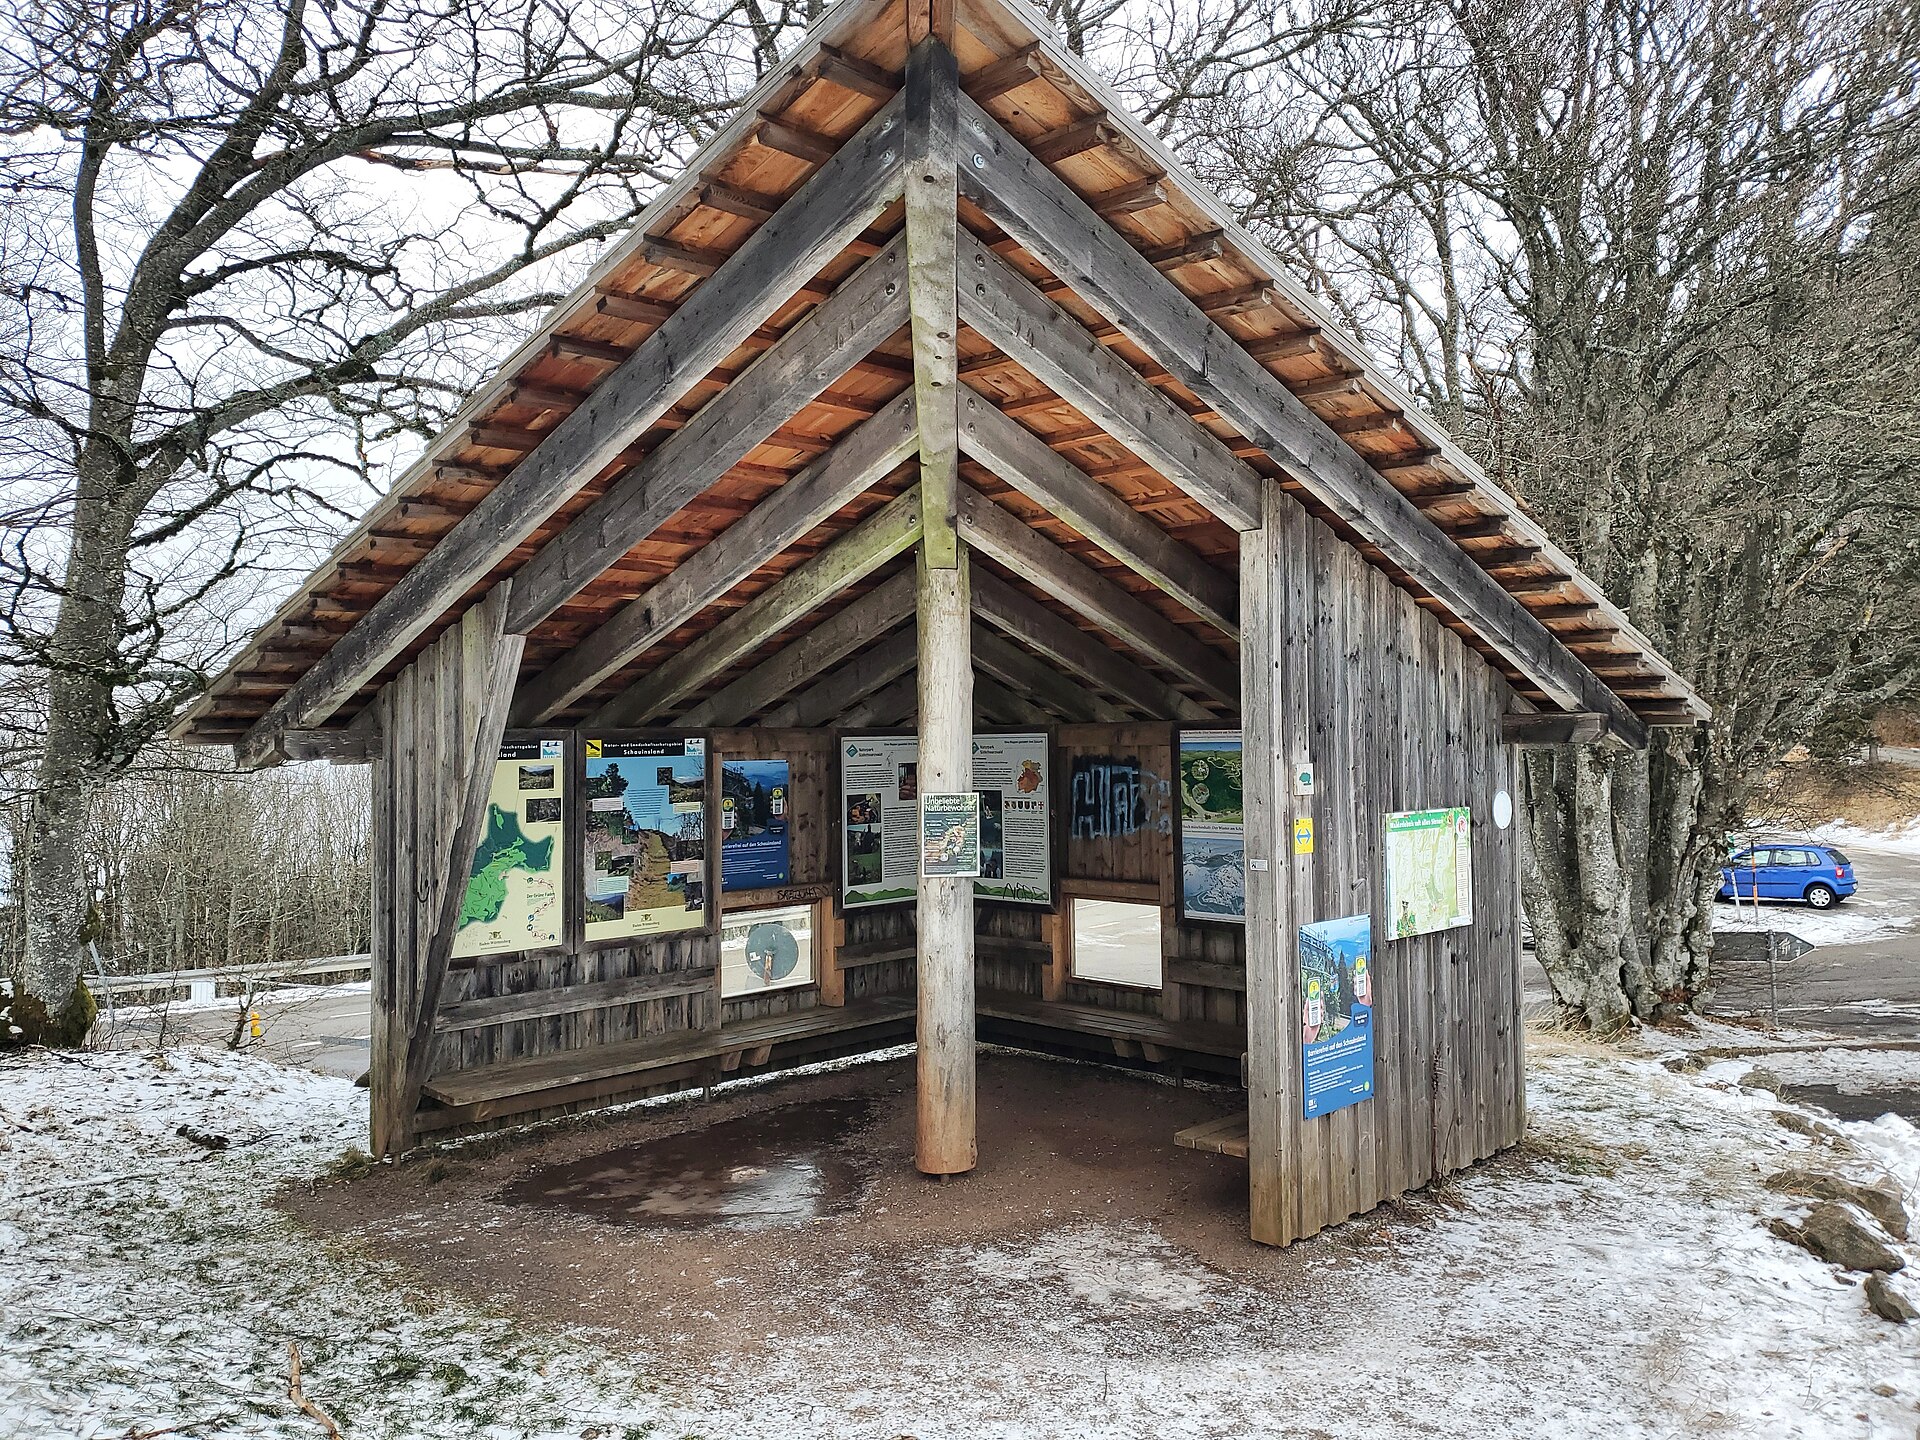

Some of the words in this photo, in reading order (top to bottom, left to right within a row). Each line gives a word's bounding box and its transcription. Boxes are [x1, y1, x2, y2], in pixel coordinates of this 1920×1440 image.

[623, 748, 665, 756] Schauinsland
[925, 795, 961, 805] Unbeliebte
[925, 803, 976, 812] Naturbewohner
[1308, 1045, 1329, 1057] Barrierefrei
[1343, 1034, 1366, 1046] Schauinsland
